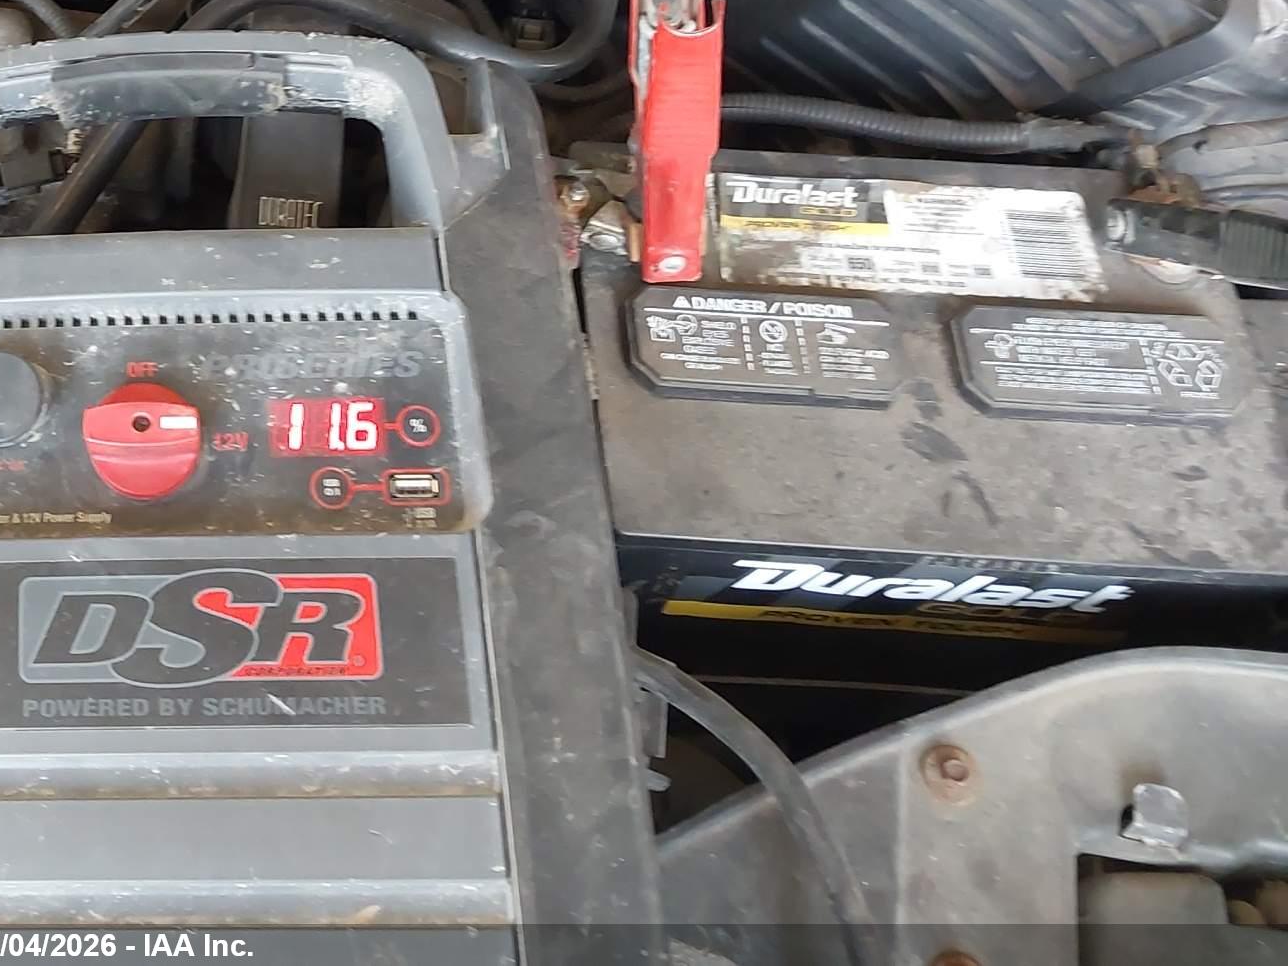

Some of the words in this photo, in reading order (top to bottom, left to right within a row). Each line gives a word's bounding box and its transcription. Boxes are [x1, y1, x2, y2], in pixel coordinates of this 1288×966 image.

[726, 181, 860, 208] Duralast
[691, 296, 767, 313] DANGER
[783, 302, 854, 319] POISON
[126, 361, 159, 378] OFF
[43, 512, 75, 523] Power
[730, 559, 1135, 614] Duralast
[31, 567, 366, 689] DSR
[22, 696, 150, 719] POWERED
[159, 697, 193, 718] BY
[201, 695, 387, 718] SCHUMACHER
